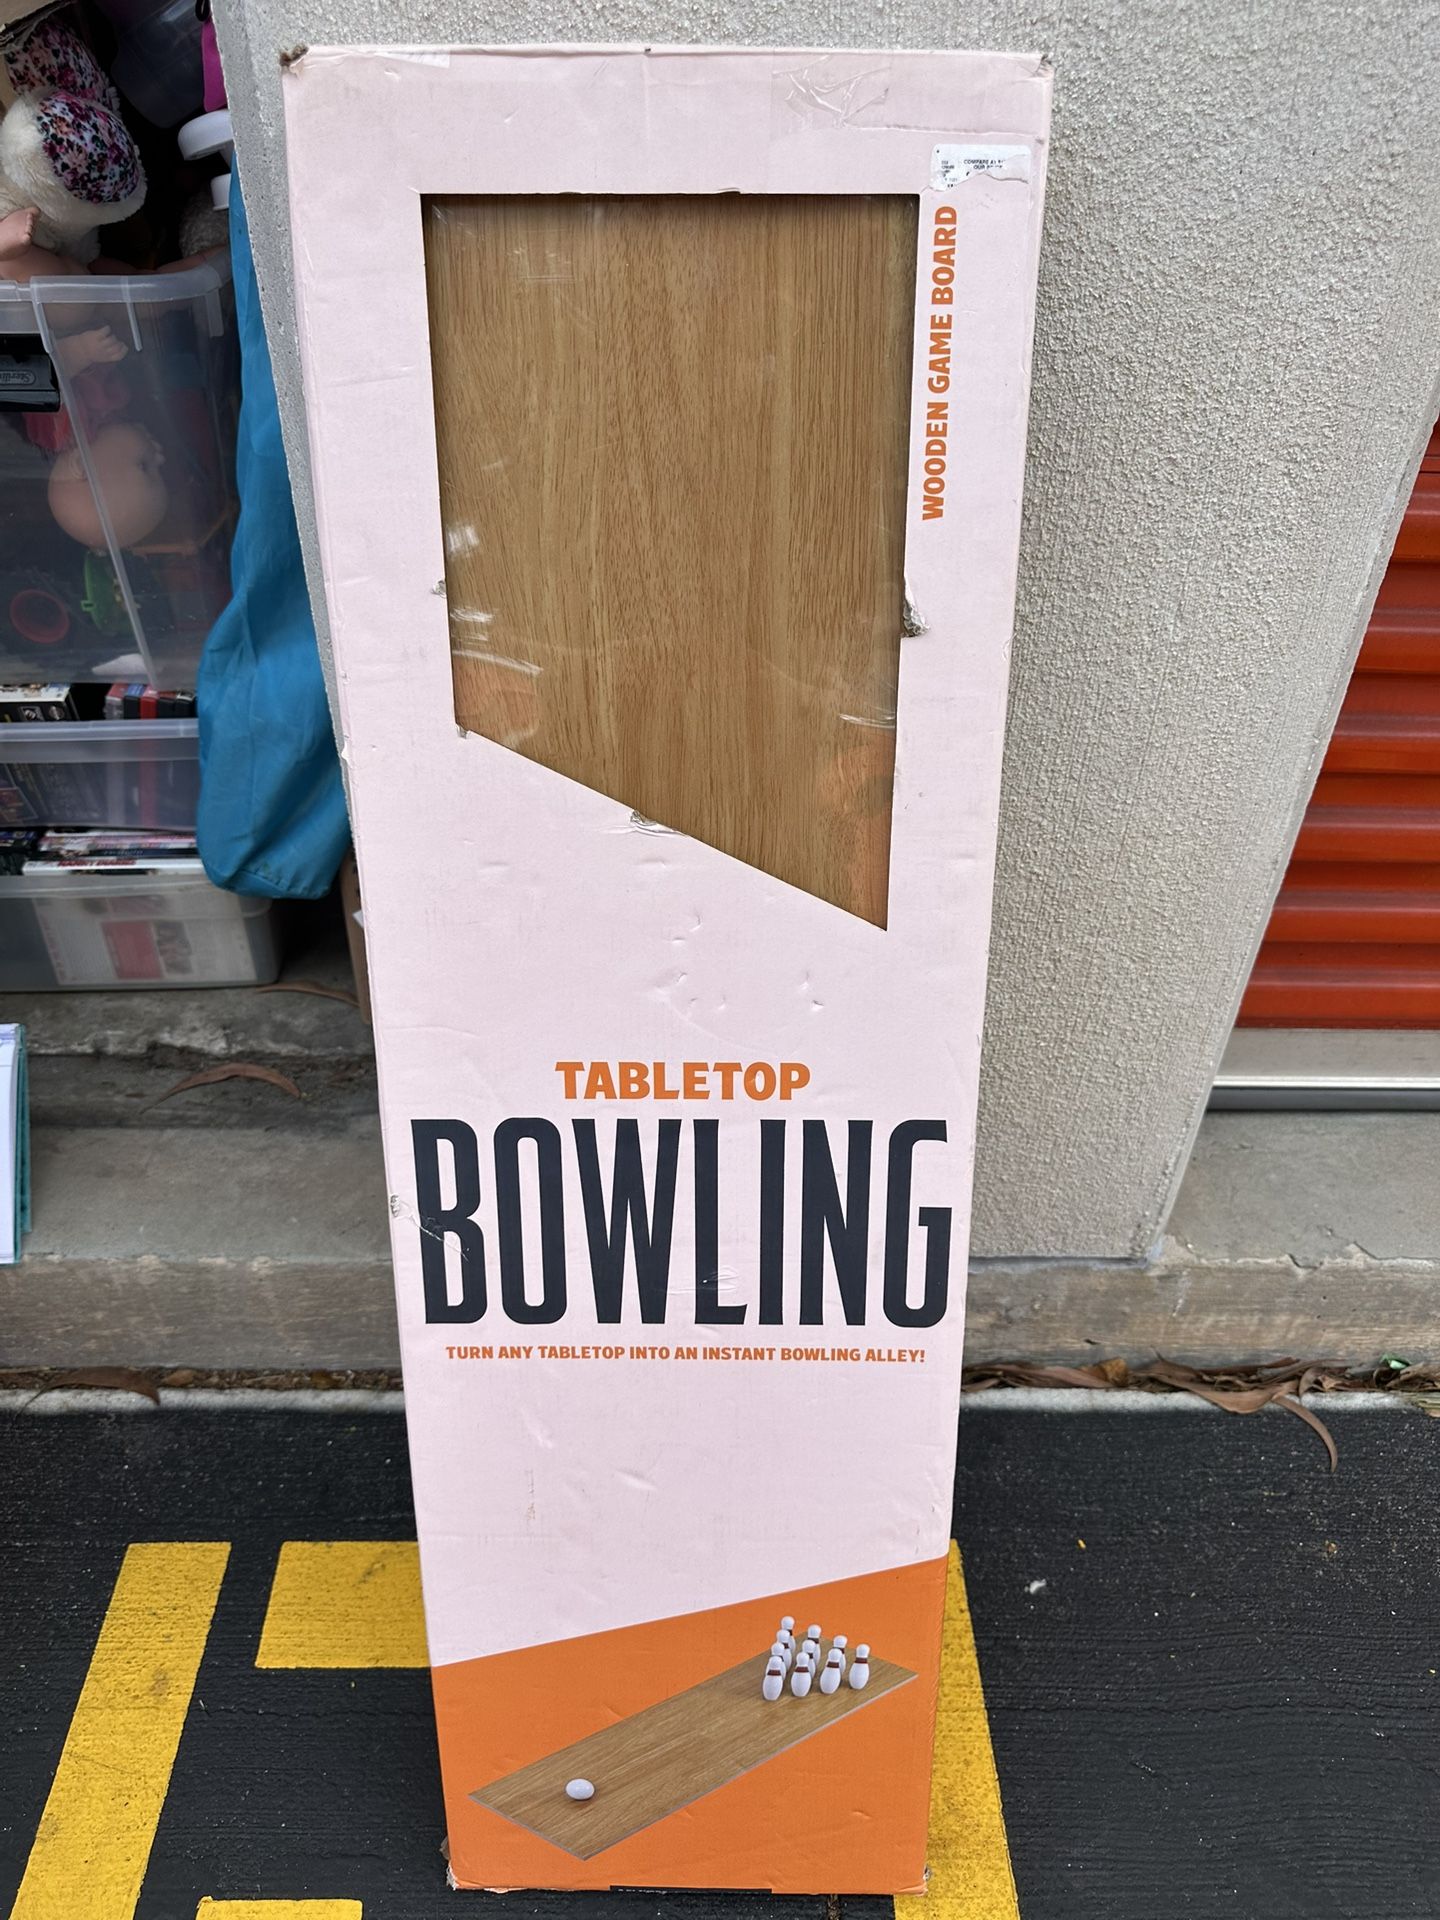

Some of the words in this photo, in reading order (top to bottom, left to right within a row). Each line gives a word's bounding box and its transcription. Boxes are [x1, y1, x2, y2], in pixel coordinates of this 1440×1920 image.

[930, 206, 957, 305] BOARD
[927, 314, 952, 394] GAME
[922, 401, 949, 521] WOODEN
[555, 1061, 811, 1101] TABLETOP
[411, 1118, 953, 1328] BOWLING
[445, 1345, 494, 1360] TURN
[497, 1345, 533, 1360] ANY
[537, 1345, 625, 1360] TABLETOP
[629, 1346, 671, 1360] INTO
[674, 1346, 698, 1360] AN
[702, 1346, 776, 1361] INSTANT
[780, 1347, 861, 1361] BOWLING
[864, 1348, 926, 1363] ALLEY!
